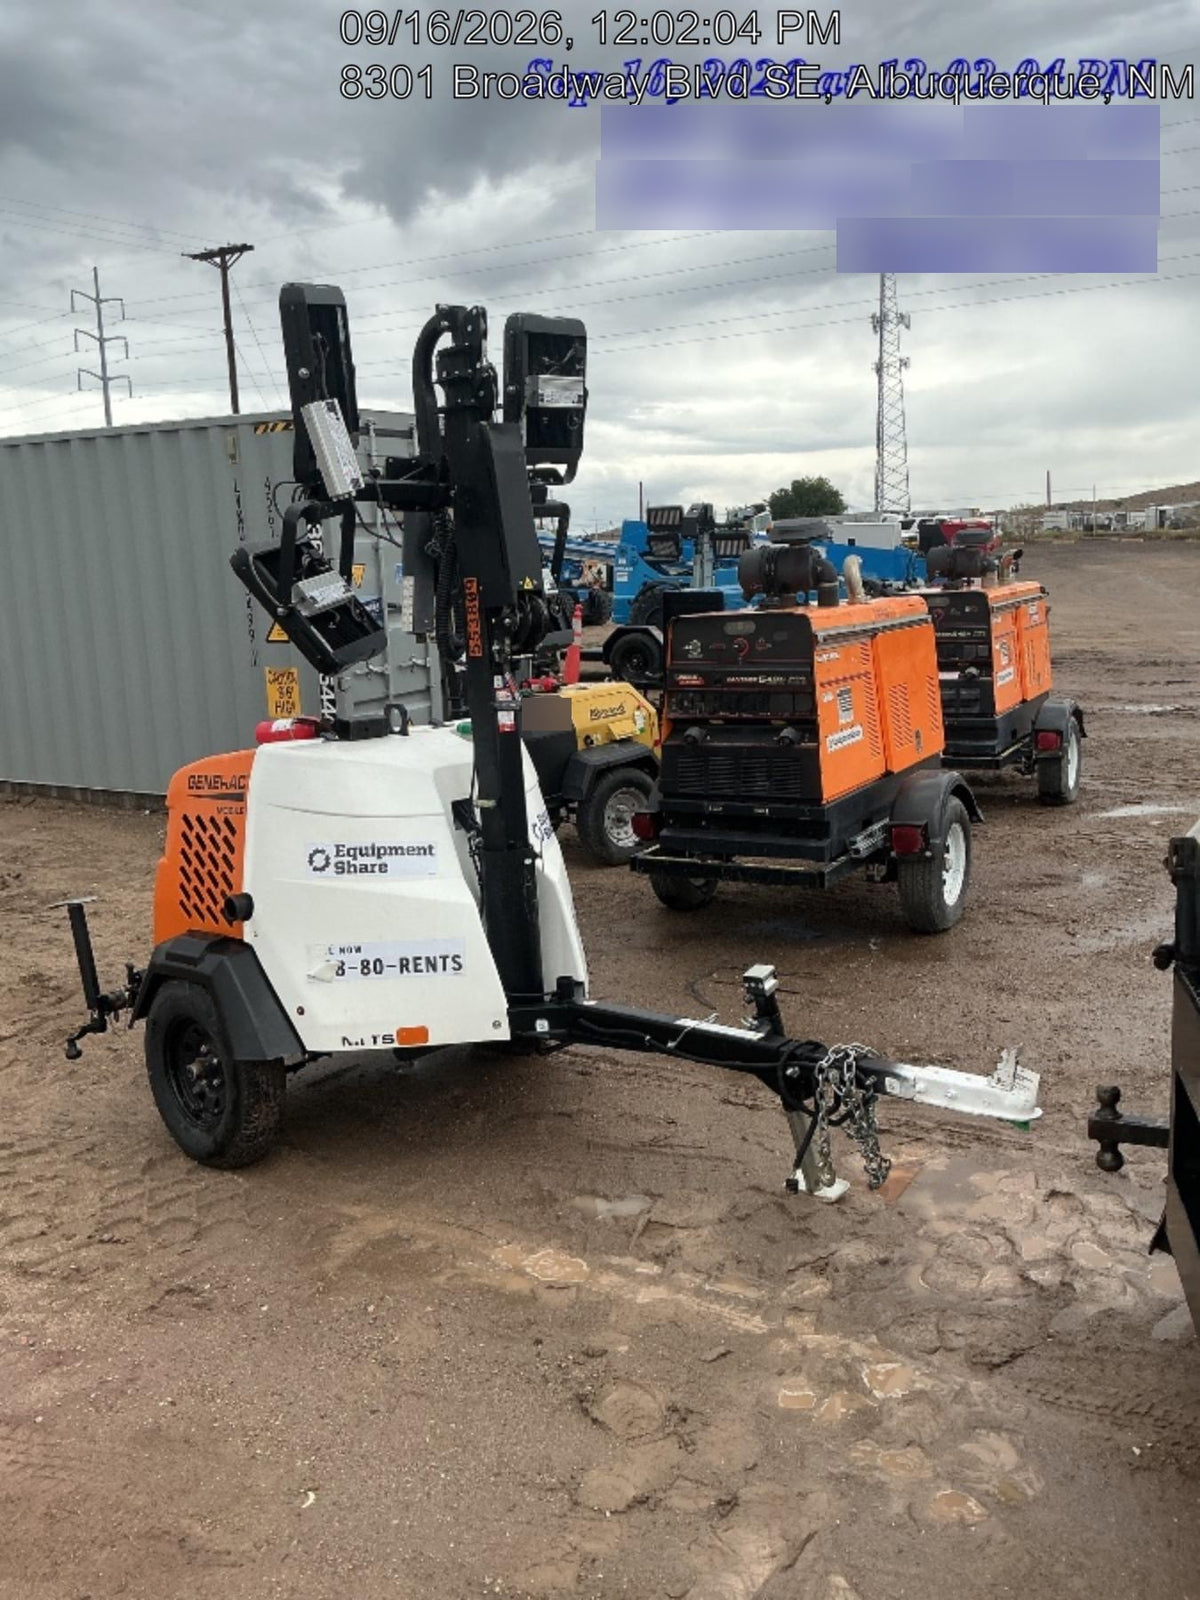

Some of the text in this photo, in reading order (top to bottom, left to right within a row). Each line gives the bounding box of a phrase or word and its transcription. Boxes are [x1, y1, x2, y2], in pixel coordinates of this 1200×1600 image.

[333, 843, 436, 861] Equipment
[333, 860, 388, 875] Share
[339, 945, 362, 955] NOW
